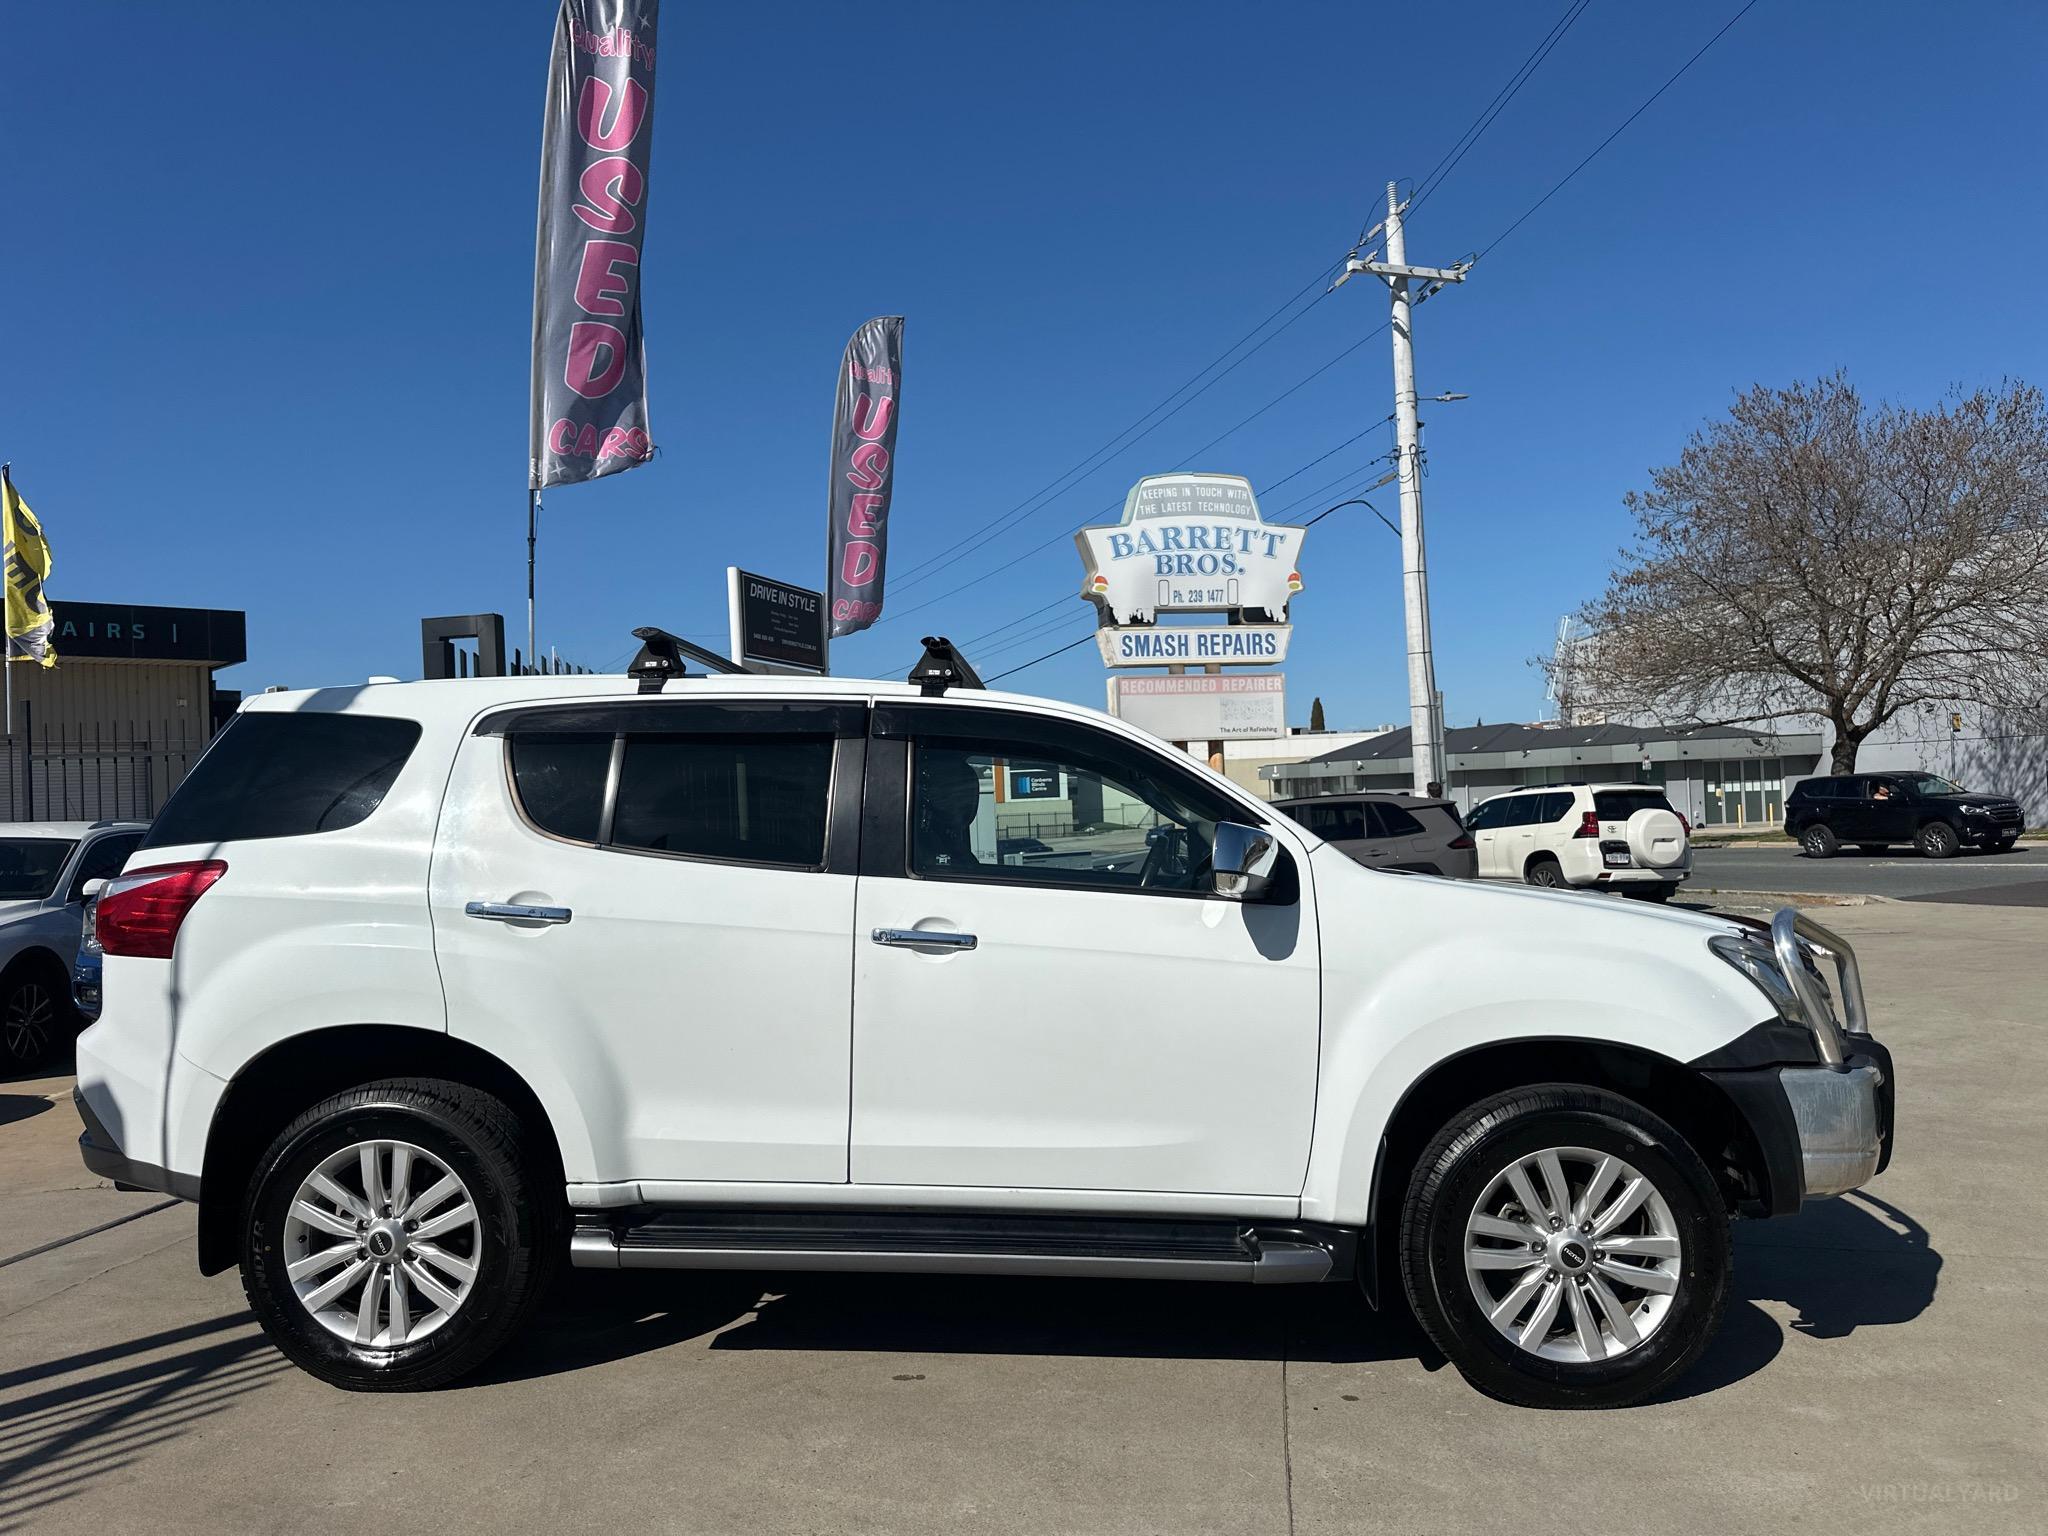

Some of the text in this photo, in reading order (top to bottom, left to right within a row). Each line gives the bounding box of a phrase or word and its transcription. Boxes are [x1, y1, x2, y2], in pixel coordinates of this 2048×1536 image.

[569, 17, 655, 71] Quality
[564, 75, 648, 399] USED
[549, 418, 649, 461] CARS
[841, 392, 895, 588] USED
[1142, 486, 1248, 500] KEEPING IN TOUCH WITH
[1140, 501, 1251, 515] THE LATEST TECHNOLOGY
[1107, 525, 1286, 560] BARRETT
[1154, 552, 1246, 576] BROS.
[750, 583, 816, 613] DRIVE IN STYLE
[1173, 589, 1224, 603] Ph. 239 1477
[833, 598, 881, 622] CAR
[61, 620, 145, 640] AIRS
[1122, 632, 1276, 657] SMASH REPAIRS
[1120, 678, 1282, 694] RECOMMENDED REPAIRER
[1250, 726, 1278, 734] Refinishing
[374, 1233, 388, 1254] ISUZU
[1563, 1247, 1585, 1264] ISUZU
